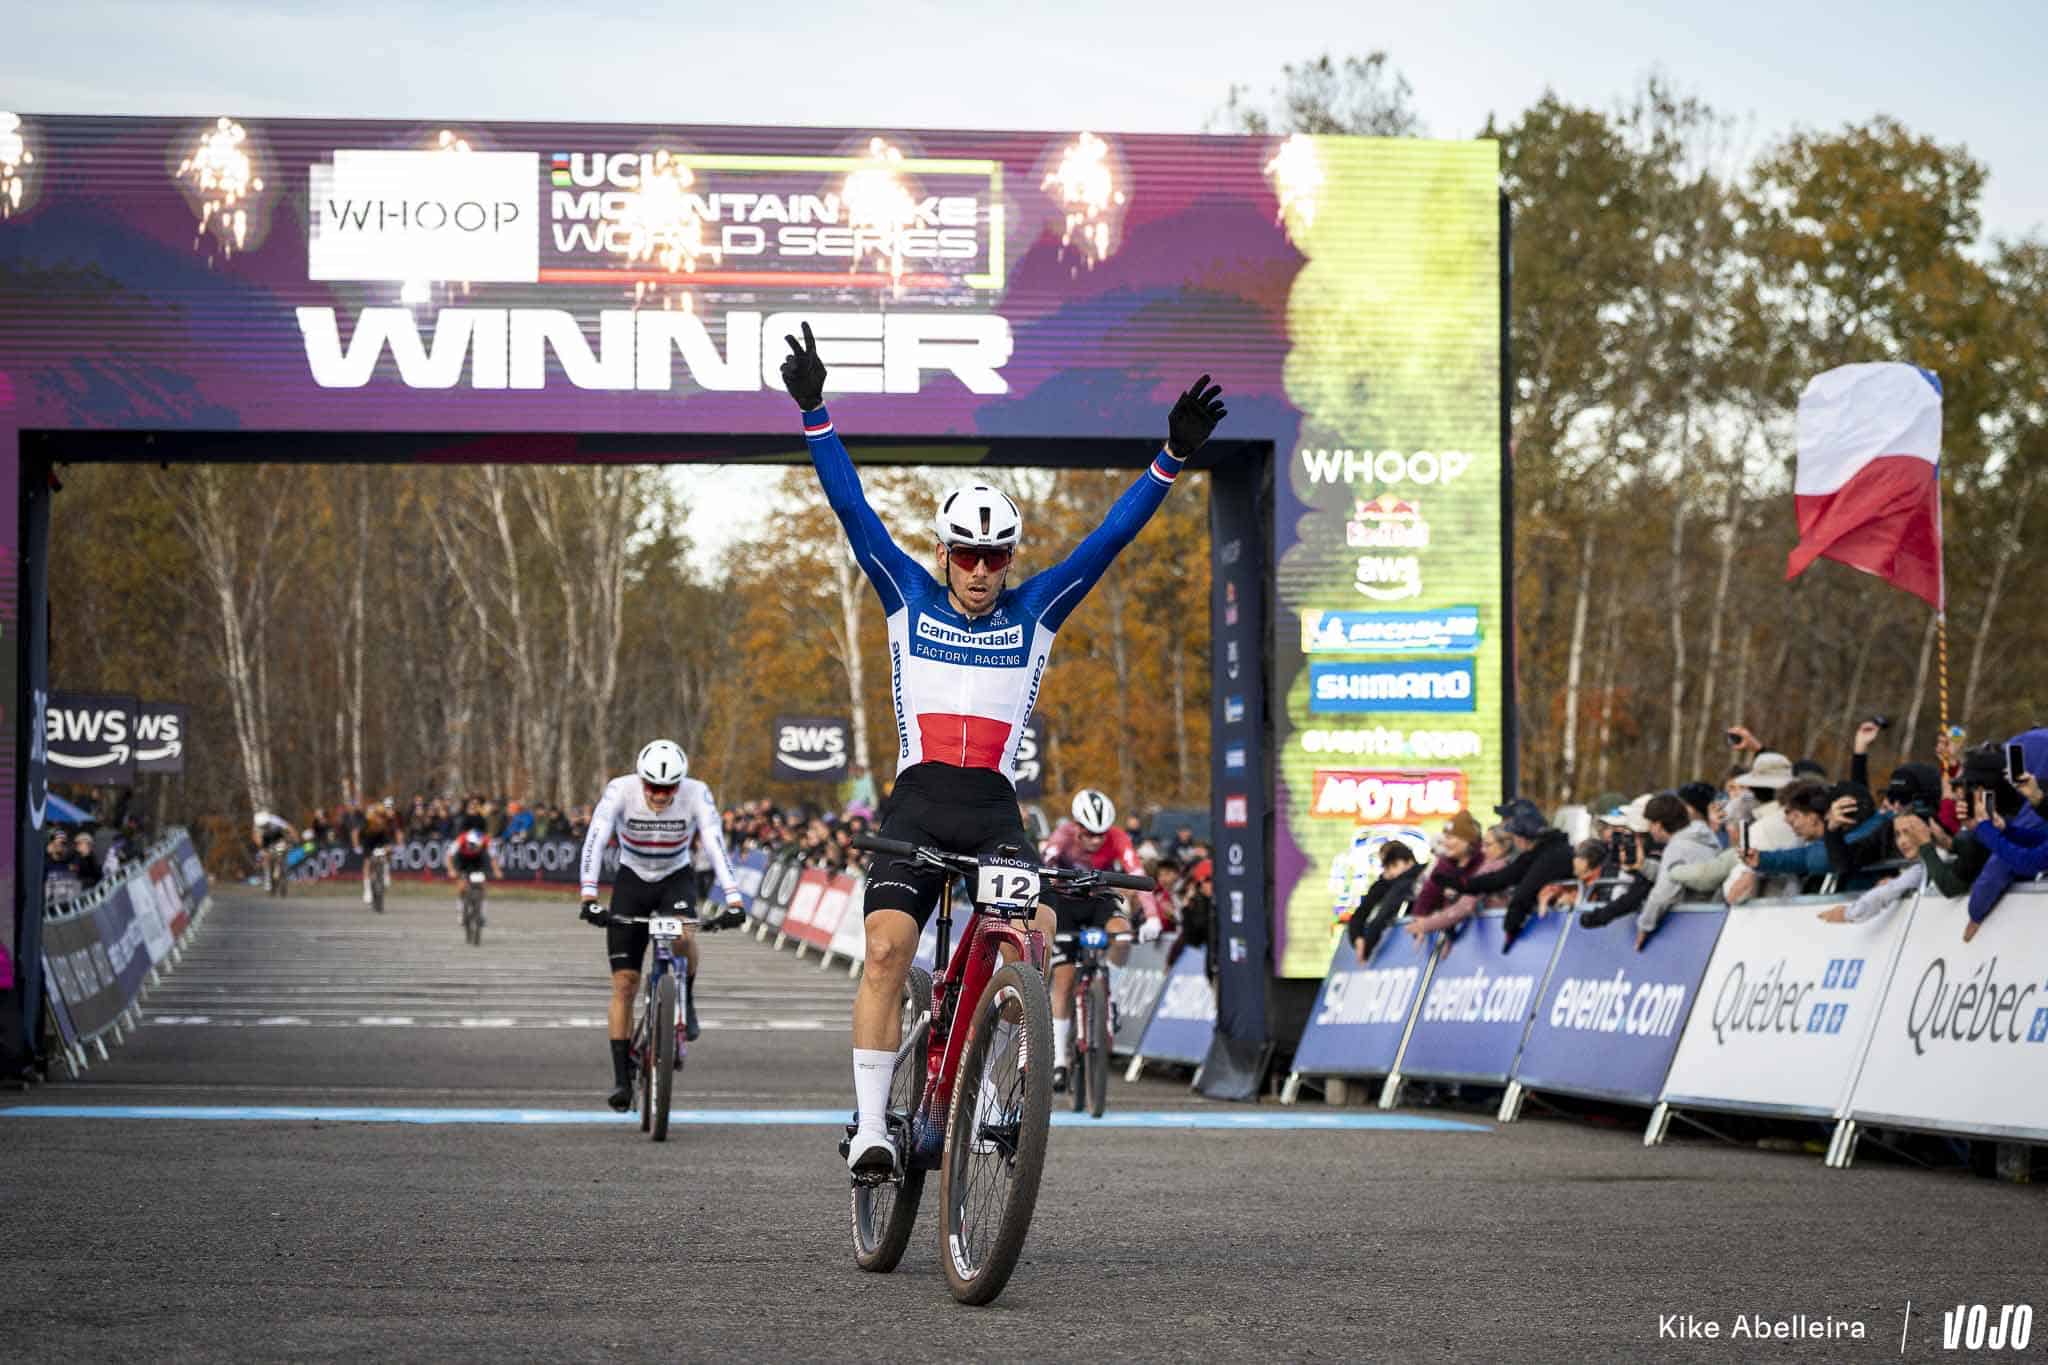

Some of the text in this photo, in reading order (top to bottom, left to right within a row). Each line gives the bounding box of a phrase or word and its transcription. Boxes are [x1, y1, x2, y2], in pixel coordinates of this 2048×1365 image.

[328, 199, 520, 232] WHOOP
[552, 191, 840, 224] MONTAIN
[296, 307, 1014, 394] WINNER
[1301, 449, 1473, 485] WHOOP
[919, 620, 1019, 647] cannondale
[916, 643, 1020, 666] FACTORY RACING
[891, 640, 910, 759] cannondale
[1316, 670, 1471, 701] SHIMANO
[134, 713, 179, 741] ws
[778, 725, 845, 753] aws
[1315, 777, 1462, 821] MOTUL
[990, 855, 1031, 869] WHOOP
[991, 873, 1031, 900] 12
[1316, 967, 1419, 1025] SHIMANO
[1423, 966, 1534, 1023] events.com
[1550, 968, 1685, 1037] events.com
[1711, 959, 1815, 1046] Québec
[1907, 955, 2037, 1056] Québec
